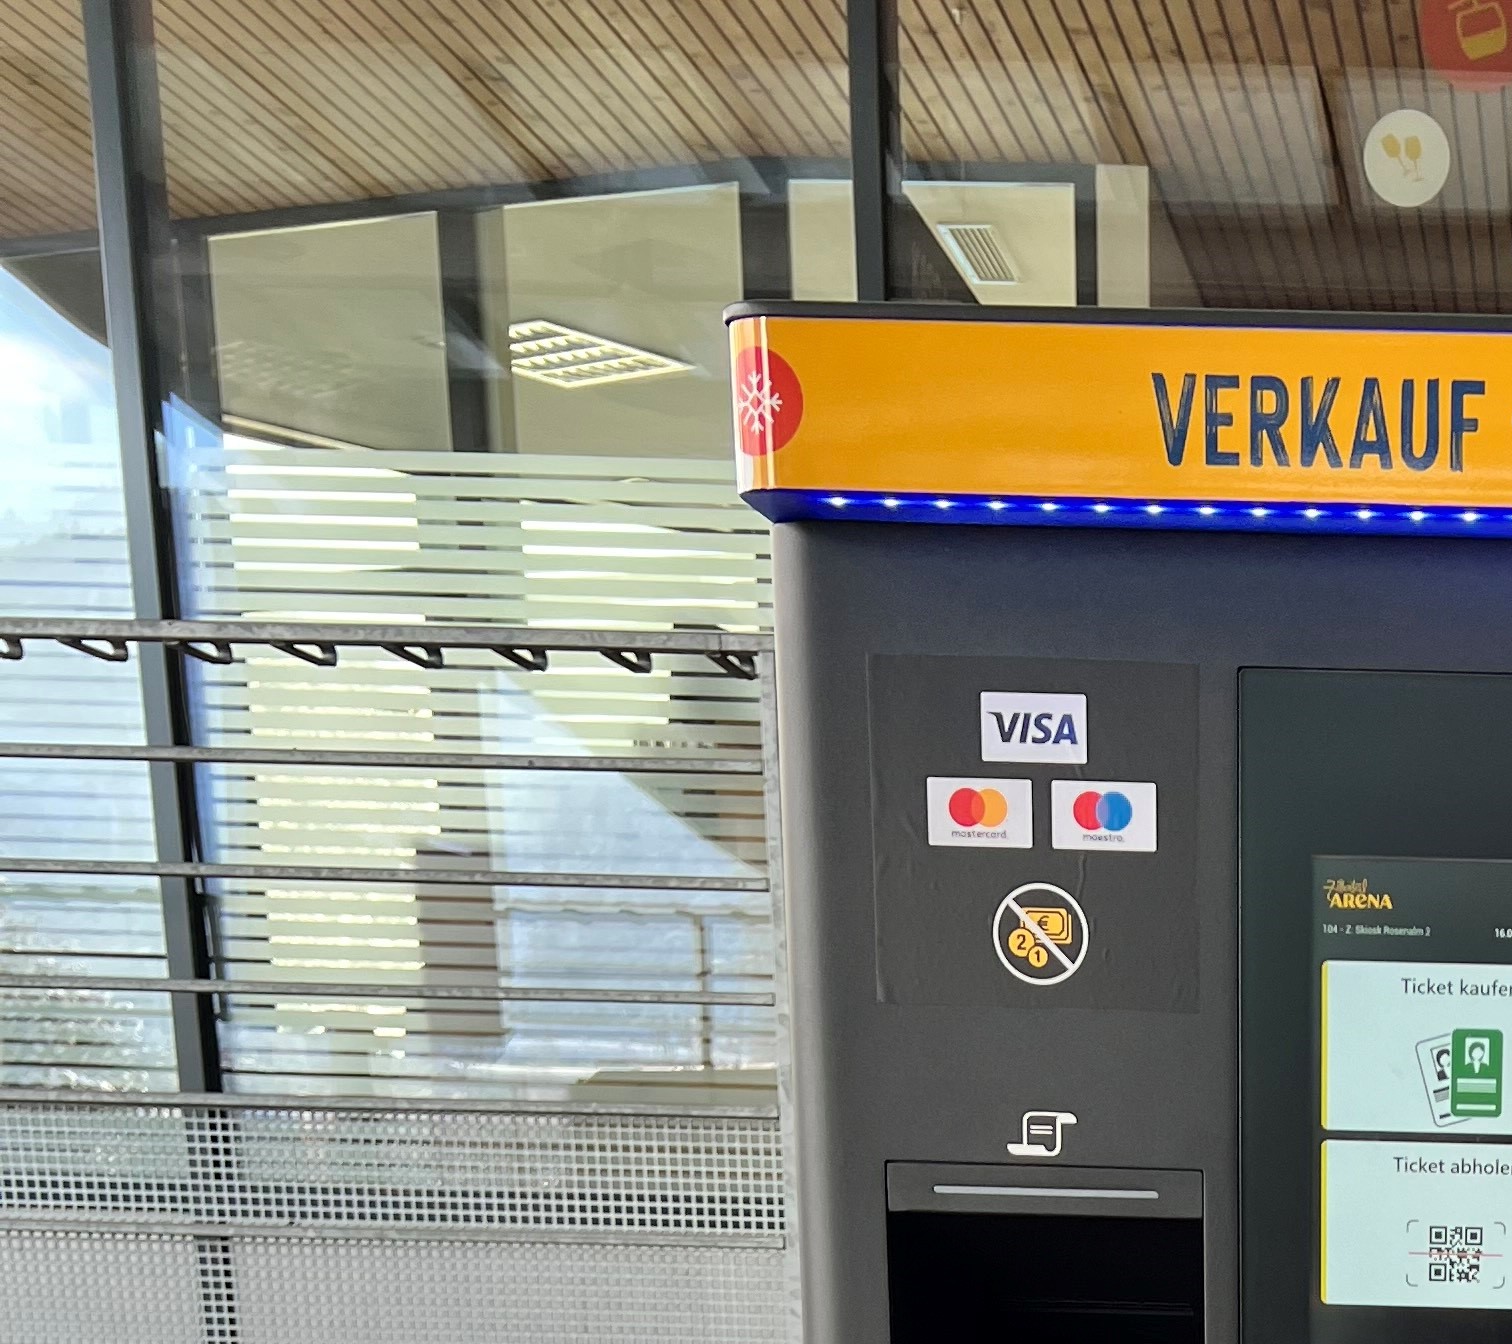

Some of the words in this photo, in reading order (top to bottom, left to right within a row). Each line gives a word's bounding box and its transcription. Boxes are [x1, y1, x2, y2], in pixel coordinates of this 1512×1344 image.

[1148, 370, 1490, 476] VERKAUF
[986, 710, 1079, 746] VISA
[1322, 923, 1338, 935] 104
[1400, 976, 1454, 996] Ticket
[1392, 1156, 1446, 1176] Ticket
